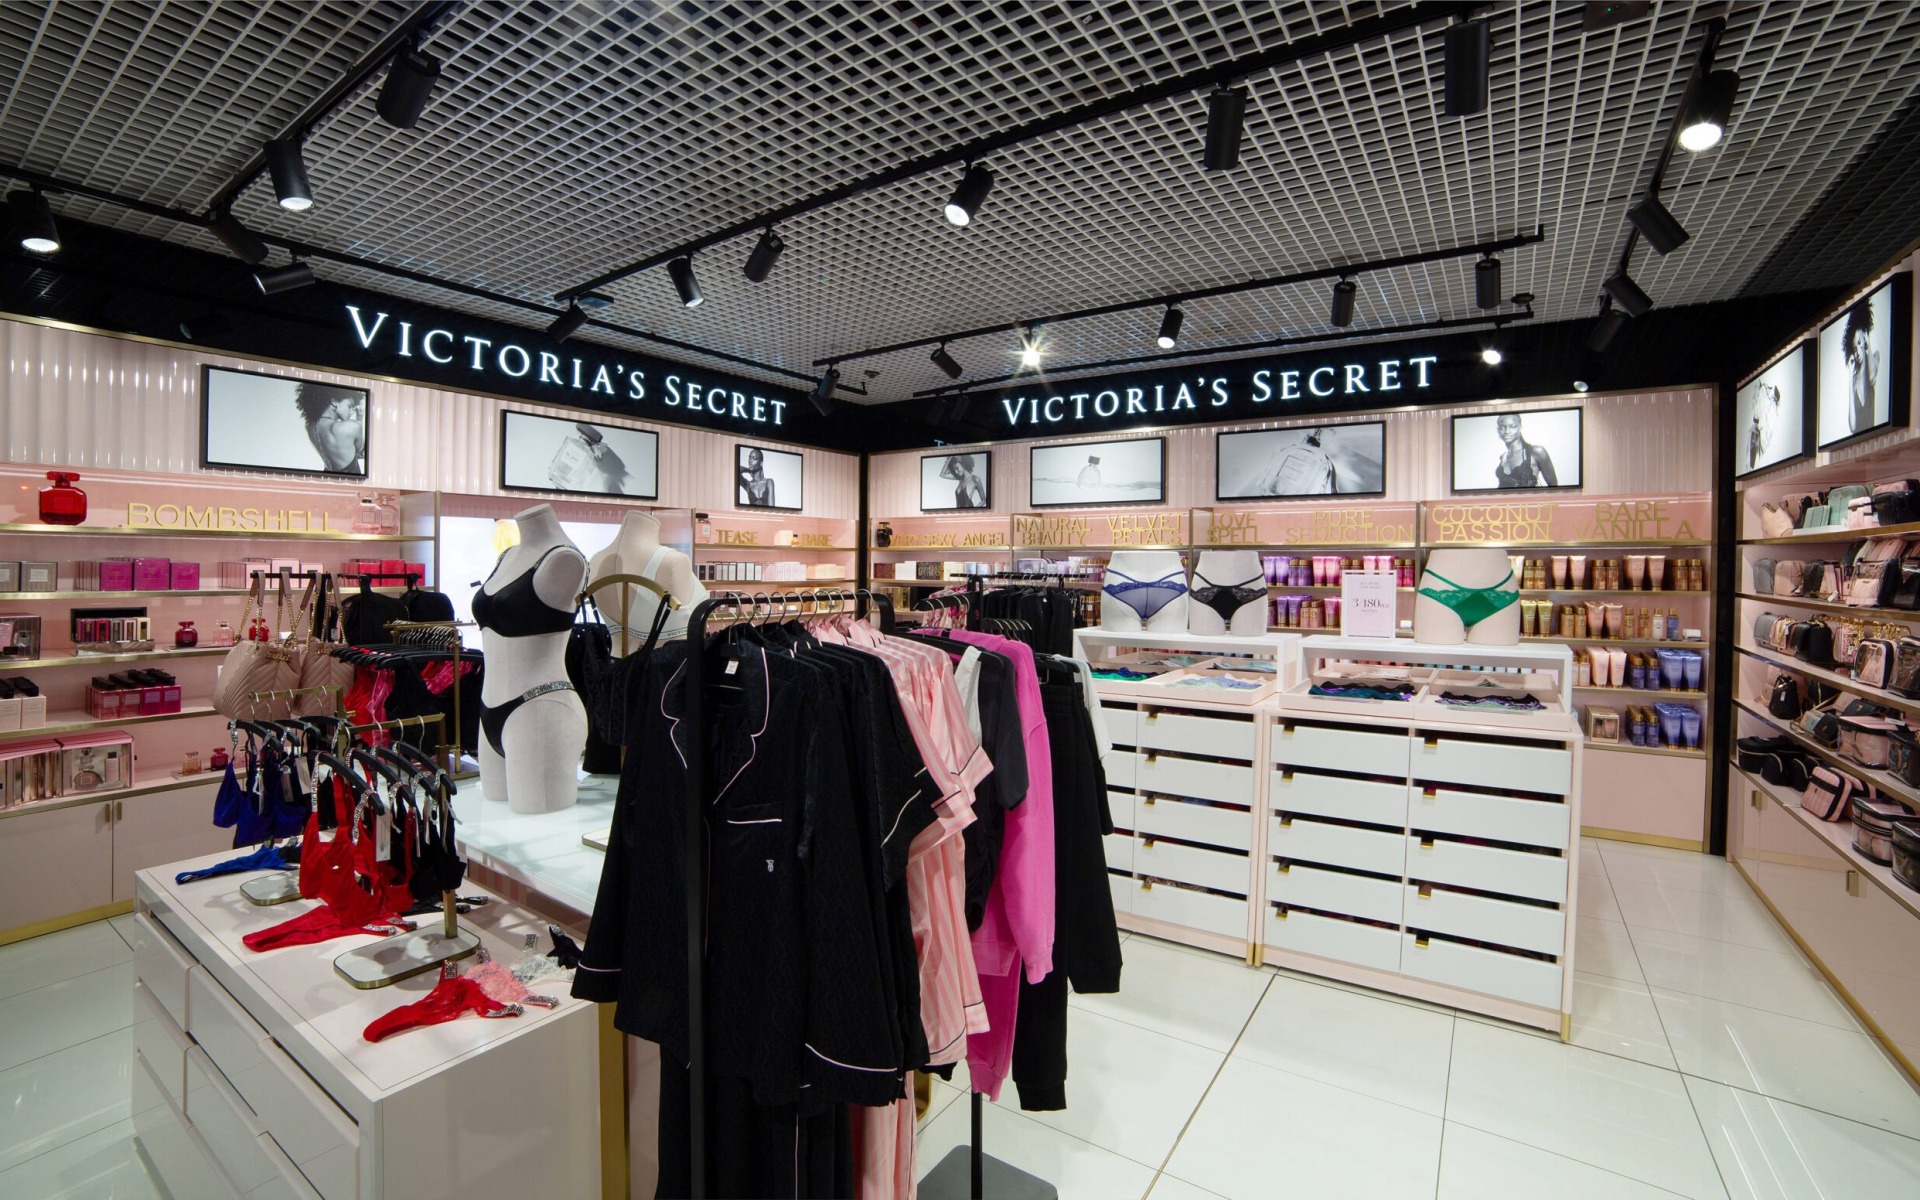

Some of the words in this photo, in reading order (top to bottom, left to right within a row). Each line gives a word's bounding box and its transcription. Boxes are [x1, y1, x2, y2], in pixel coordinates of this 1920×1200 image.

[345, 305, 645, 399] VICTORIA'S
[664, 375, 787, 425] SECRET
[1002, 377, 1229, 426] VICTORIA'S
[1252, 356, 1437, 402] SECRET
[127, 502, 340, 532] BOMBSHELL
[1312, 508, 1374, 527] PURE
[1432, 504, 1559, 523] COCONUT
[1595, 501, 1670, 521] BARE
[1016, 516, 1092, 532] NATURAL
[1106, 513, 1185, 529] VELVET
[1210, 512, 1257, 529] LOVE
[715, 529, 760, 544] TEASE
[1022, 530, 1087, 546] BEAUTY
[1112, 528, 1182, 545] PETALS
[1206, 527, 1264, 544] SPELL
[1285, 524, 1414, 544] SEDUCTION
[1439, 522, 1550, 541] PASSION
[1573, 519, 1697, 540] VANILLA
[801, 533, 834, 546] BARE
[890, 534, 920, 546] VERY
[923, 533, 957, 546] SEXY
[963, 532, 1009, 546] ANGEL
